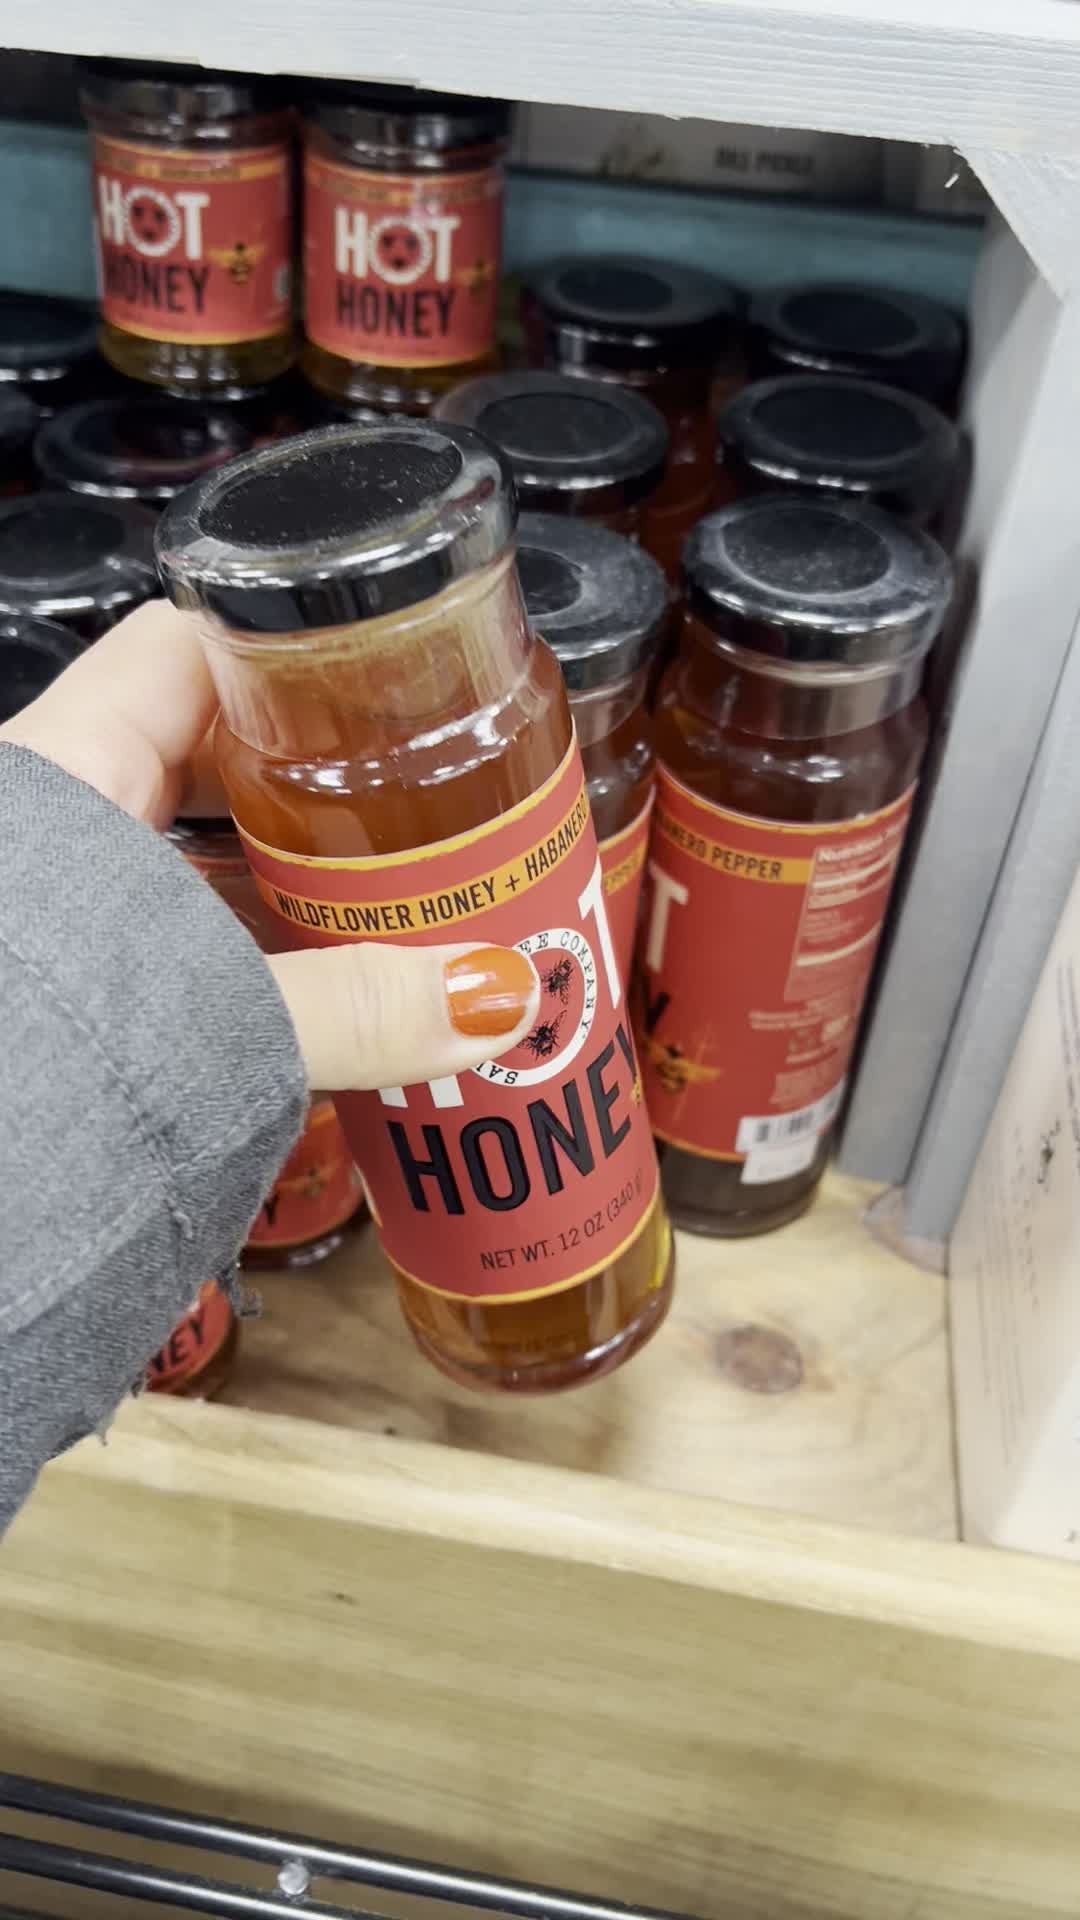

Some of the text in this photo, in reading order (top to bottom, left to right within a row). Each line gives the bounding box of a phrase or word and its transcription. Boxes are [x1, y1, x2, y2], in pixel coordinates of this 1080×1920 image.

[99, 176, 210, 261] HOT
[335, 205, 462, 285] HOT
[336, 279, 456, 340] HONEY
[711, 846, 783, 880] PEPPER
[274, 889, 415, 933] WILDFLOWER
[419, 876, 497, 925] HONEY
[505, 874, 520, 892] +
[480, 1249, 518, 1271] NET
[521, 1239, 555, 1263] WT.
[558, 1227, 582, 1251] 12
[583, 1211, 606, 1238] OZ
